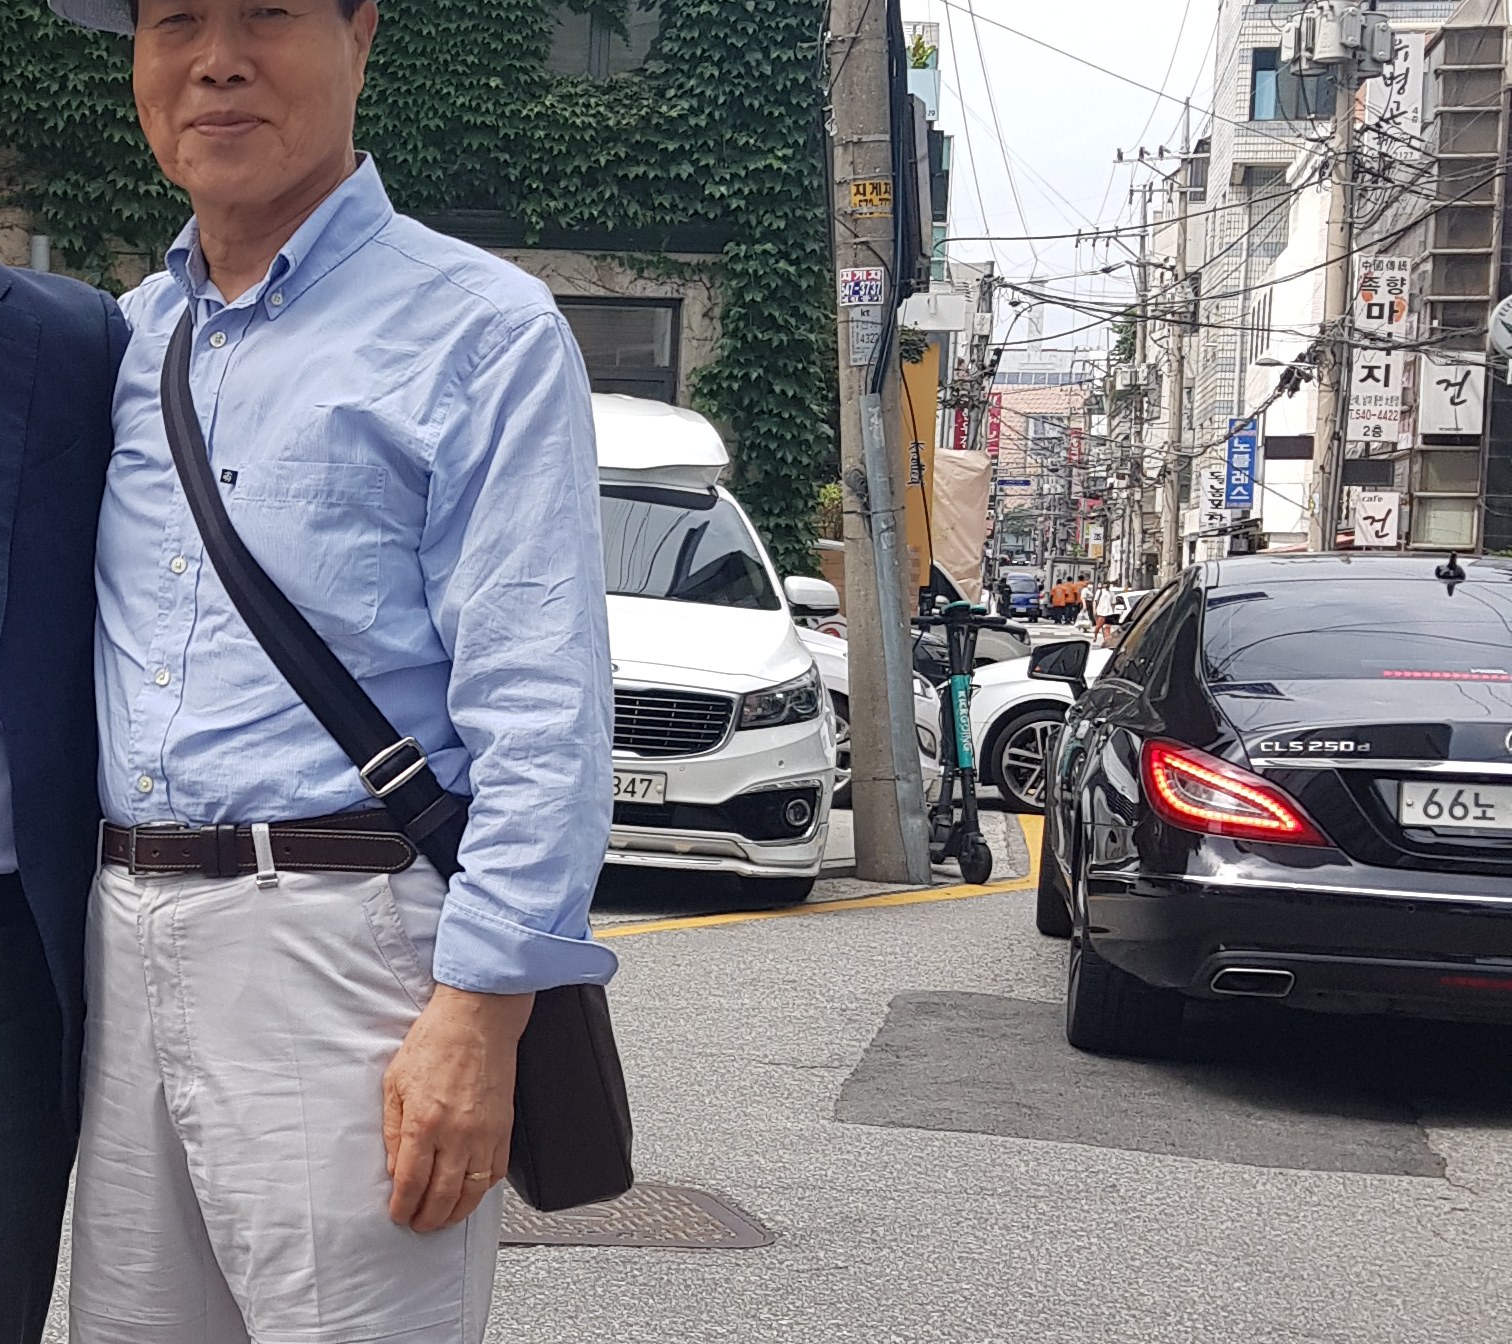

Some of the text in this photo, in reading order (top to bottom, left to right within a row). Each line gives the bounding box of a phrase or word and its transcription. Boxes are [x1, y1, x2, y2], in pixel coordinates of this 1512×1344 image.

[1361, 495, 1384, 503] cafe
[1260, 741, 1304, 752] CLS
[1422, 787, 1496, 821] 66노
